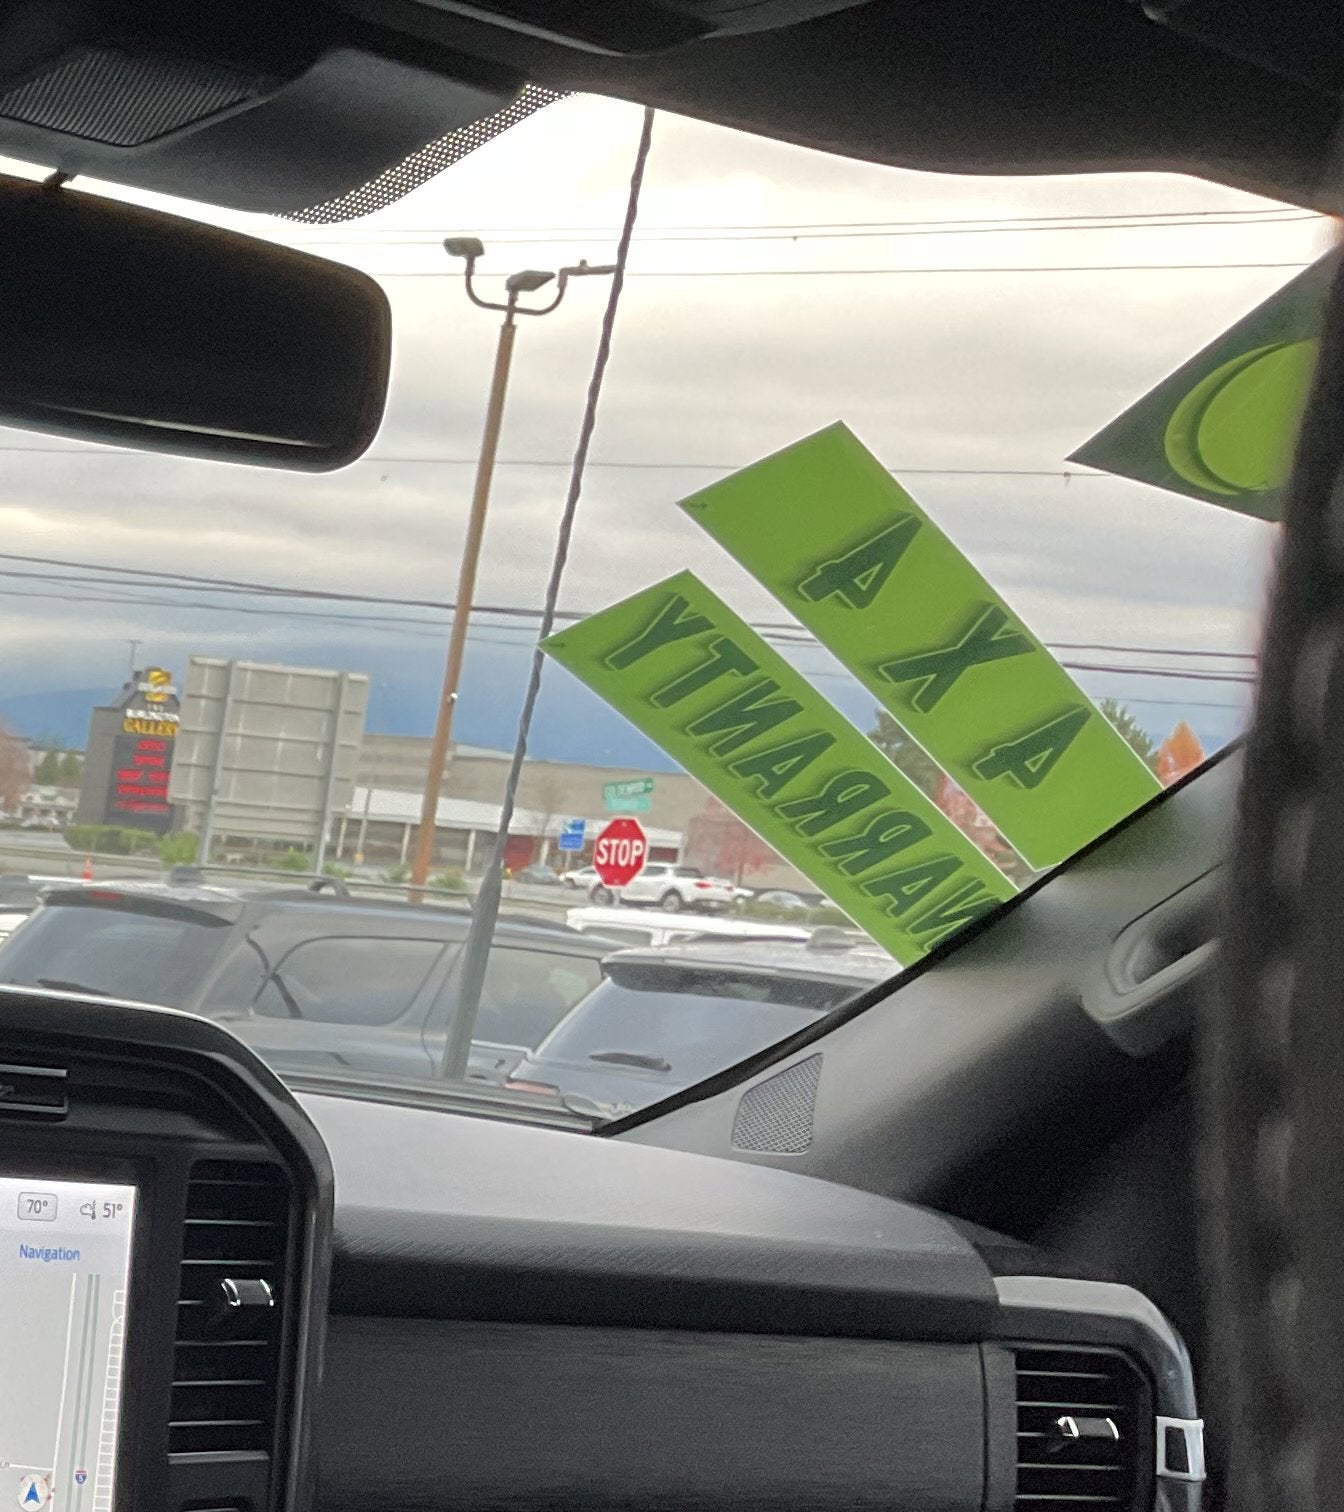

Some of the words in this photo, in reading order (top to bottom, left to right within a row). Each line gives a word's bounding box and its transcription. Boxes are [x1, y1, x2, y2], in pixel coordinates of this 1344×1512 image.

[596, 838, 644, 867] STOP
[27, 1199, 49, 1214] 70°
[103, 1202, 123, 1218] 51°
[19, 1244, 80, 1262] Navigation
